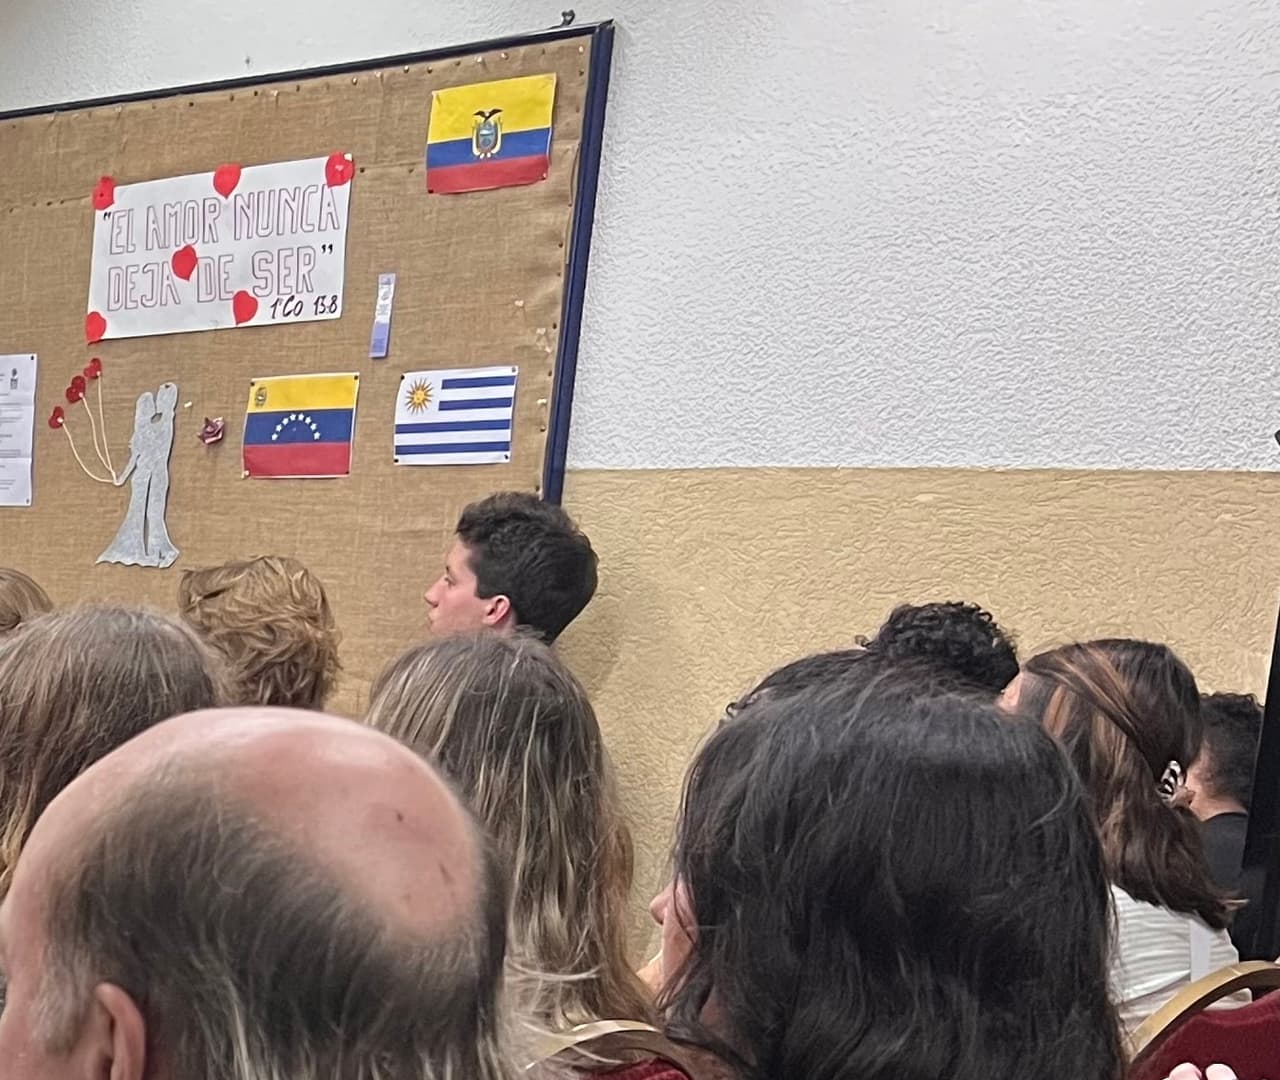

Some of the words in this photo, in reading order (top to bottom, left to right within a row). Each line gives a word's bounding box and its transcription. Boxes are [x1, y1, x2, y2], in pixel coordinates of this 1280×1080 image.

[145, 197, 221, 251] AMOR
[233, 184, 340, 241] NUNCA
[107, 262, 182, 312] DEJA
[196, 254, 235, 304] DE
